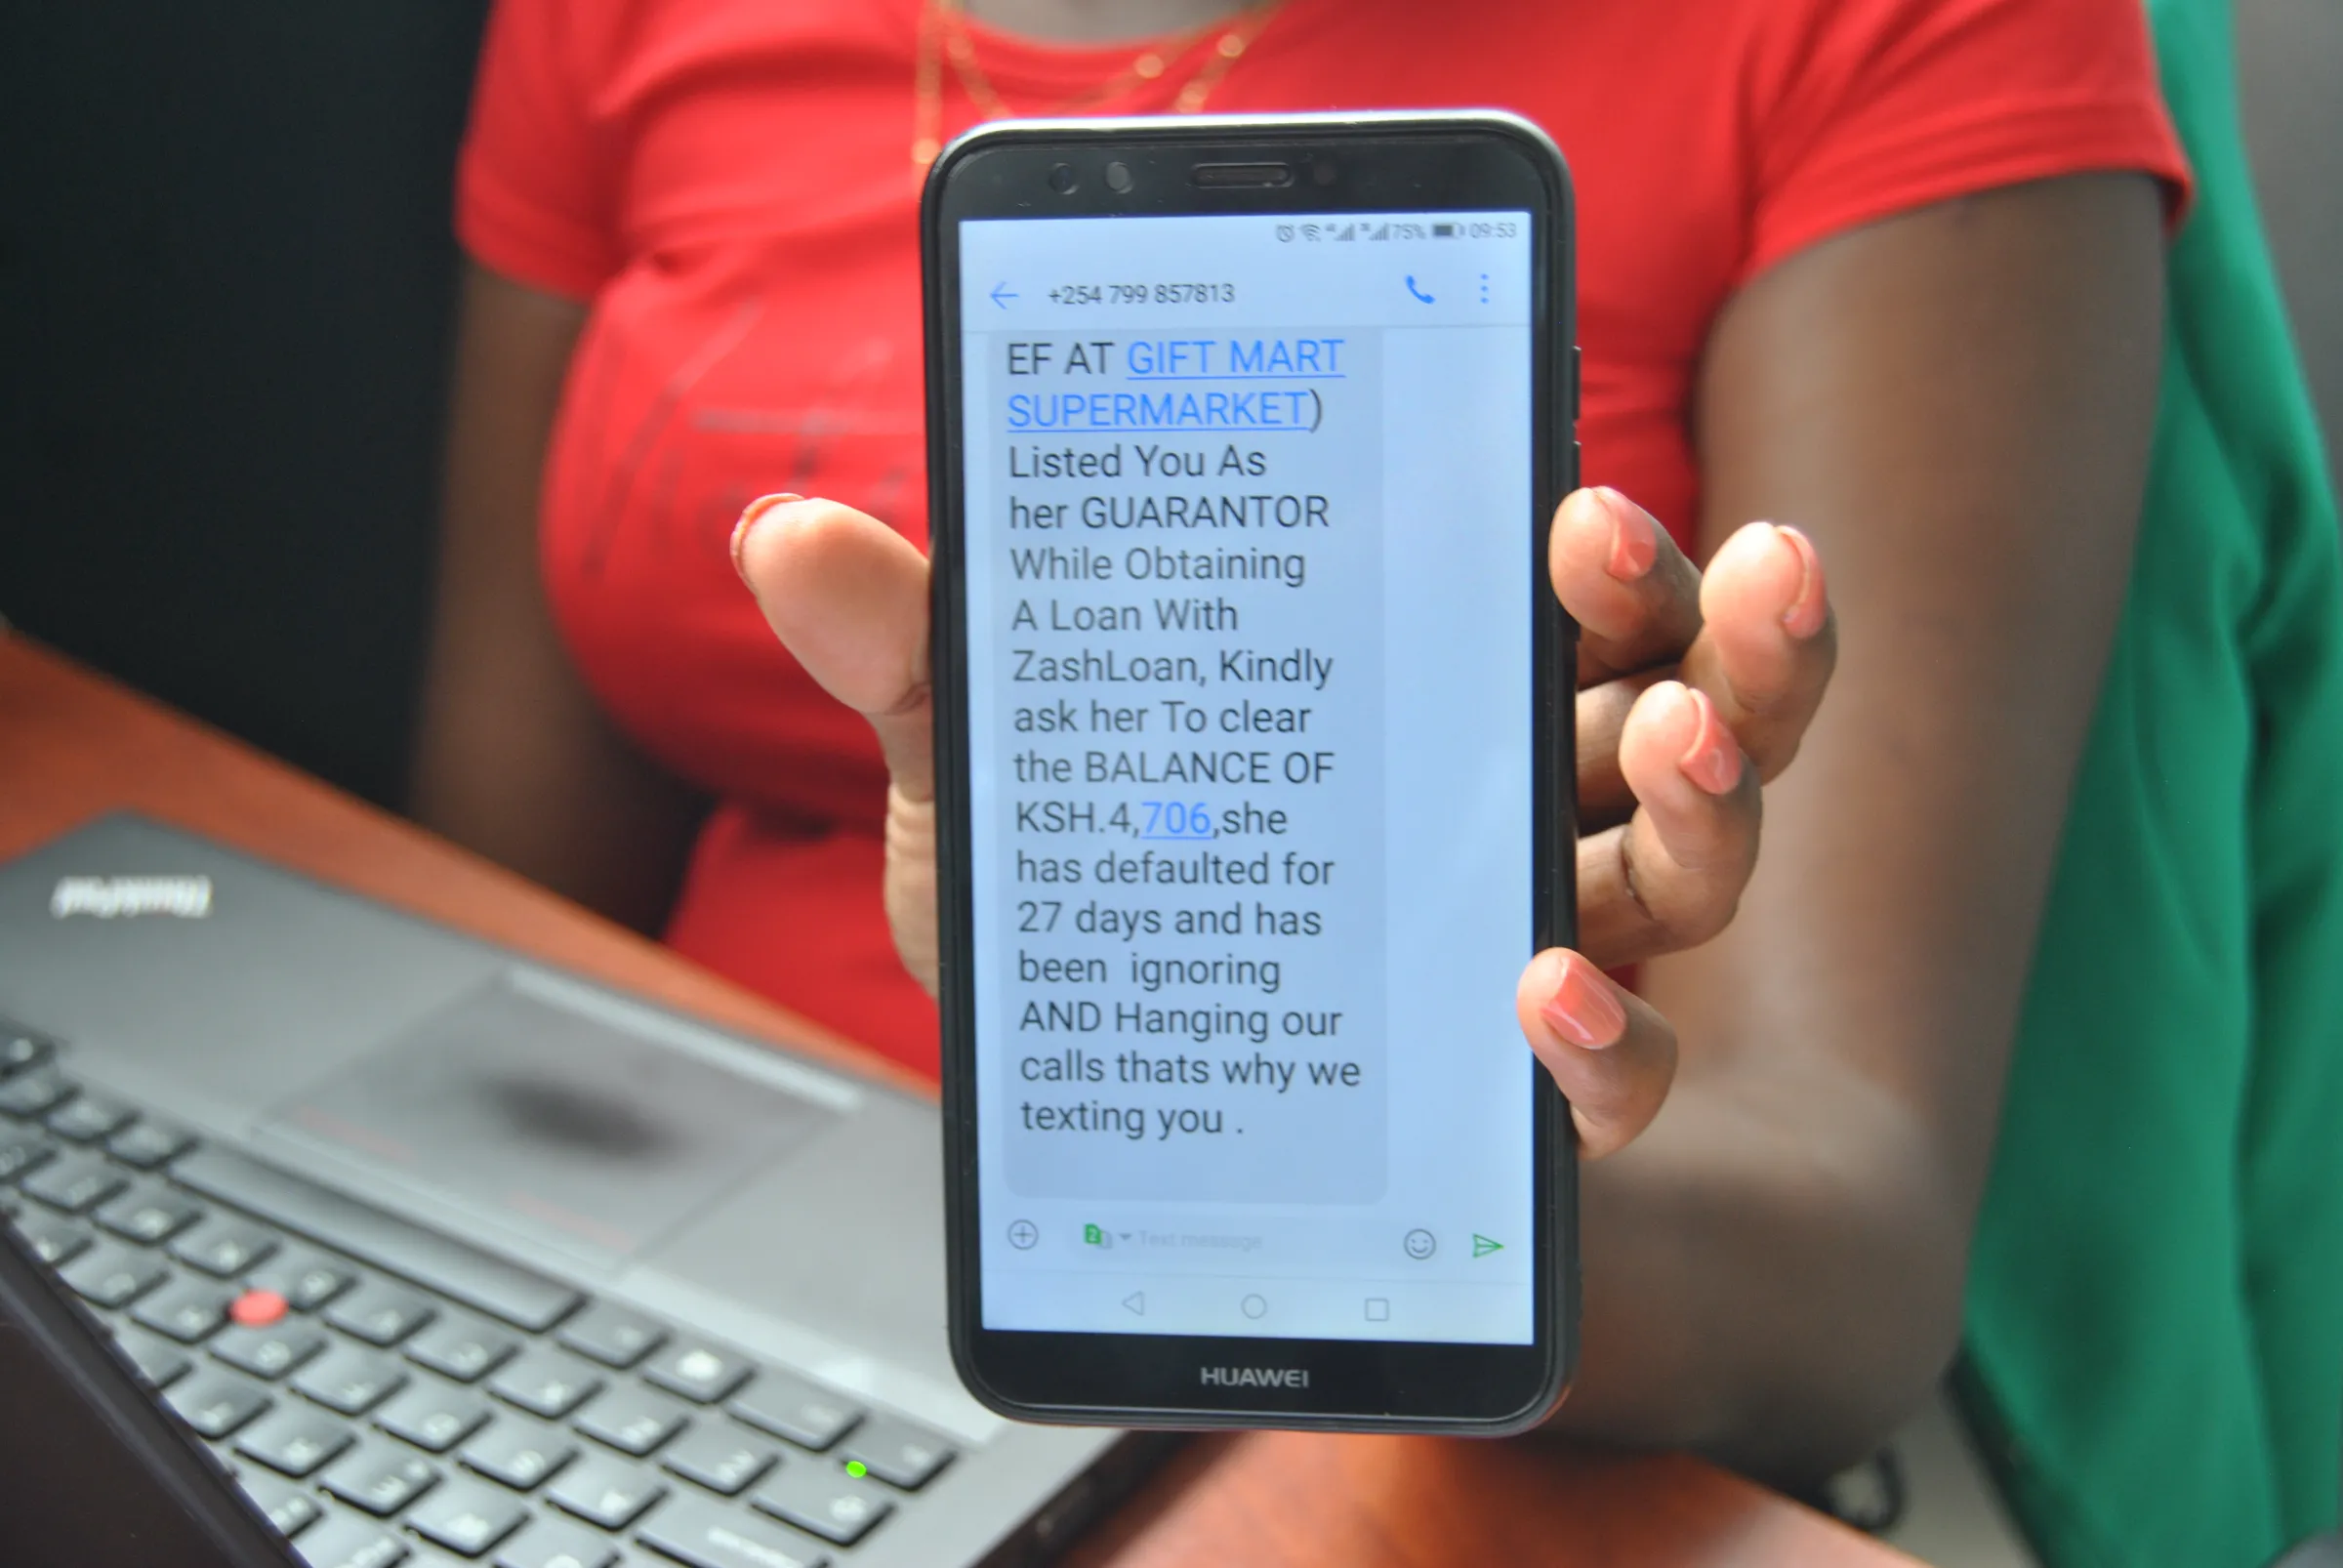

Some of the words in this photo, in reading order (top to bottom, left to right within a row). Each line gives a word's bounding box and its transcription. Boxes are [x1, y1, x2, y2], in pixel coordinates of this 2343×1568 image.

[1393, 224, 1426, 240] 75%
[1469, 223, 1517, 240] 09:53
[1048, 285, 1102, 305] +254
[1108, 284, 1148, 304] 799
[1154, 282, 1235, 304] 857813
[1007, 343, 1052, 375] EF
[1065, 342, 1115, 374] AT
[1128, 341, 1216, 375] GIFT
[1230, 339, 1344, 374] MART
[1007, 389, 1322, 433] SUPERMARKET)
[1009, 444, 1121, 477] Listed
[1134, 445, 1204, 476] You
[1217, 444, 1266, 476] As
[1010, 496, 1069, 529] her
[1082, 495, 1329, 529] GUARANTOR
[1010, 547, 1111, 580] While
[1126, 547, 1304, 588] Obtaining
[1012, 599, 1038, 631] A
[1051, 599, 1140, 631] Loan
[1154, 598, 1237, 631] With
[1013, 649, 1206, 686] ZashLoan,
[1220, 648, 1333, 690] Kindly
[1014, 699, 1078, 732] ask
[1091, 699, 1148, 732] her
[1161, 701, 1207, 733] To
[1219, 699, 1311, 733] clear
[1013, 750, 1071, 783] the
[1086, 752, 1270, 783] BALANCE
[1284, 752, 1335, 784] OF
[1017, 849, 1082, 883] has
[1094, 850, 1268, 885] defaulted
[1282, 851, 1335, 885] for
[1018, 900, 1061, 932] 27
[1076, 901, 1161, 942] days
[1175, 902, 1241, 934] and
[1256, 902, 1322, 935] has
[1019, 949, 1106, 982] been
[1131, 952, 1280, 994] ignoring
[1019, 1001, 1100, 1032] AND
[1116, 1002, 1267, 1044] Hanging
[1282, 1011, 1342, 1036] our
[1021, 1049, 1104, 1082] calls
[1116, 1051, 1210, 1084] thats
[1222, 1052, 1295, 1093] why
[1308, 1062, 1360, 1087] we
[1020, 1100, 1144, 1140] texting
[1158, 1109, 1221, 1140] you
[1138, 1230, 1176, 1248] Text
[1201, 1367, 1309, 1387] HUAWEI
